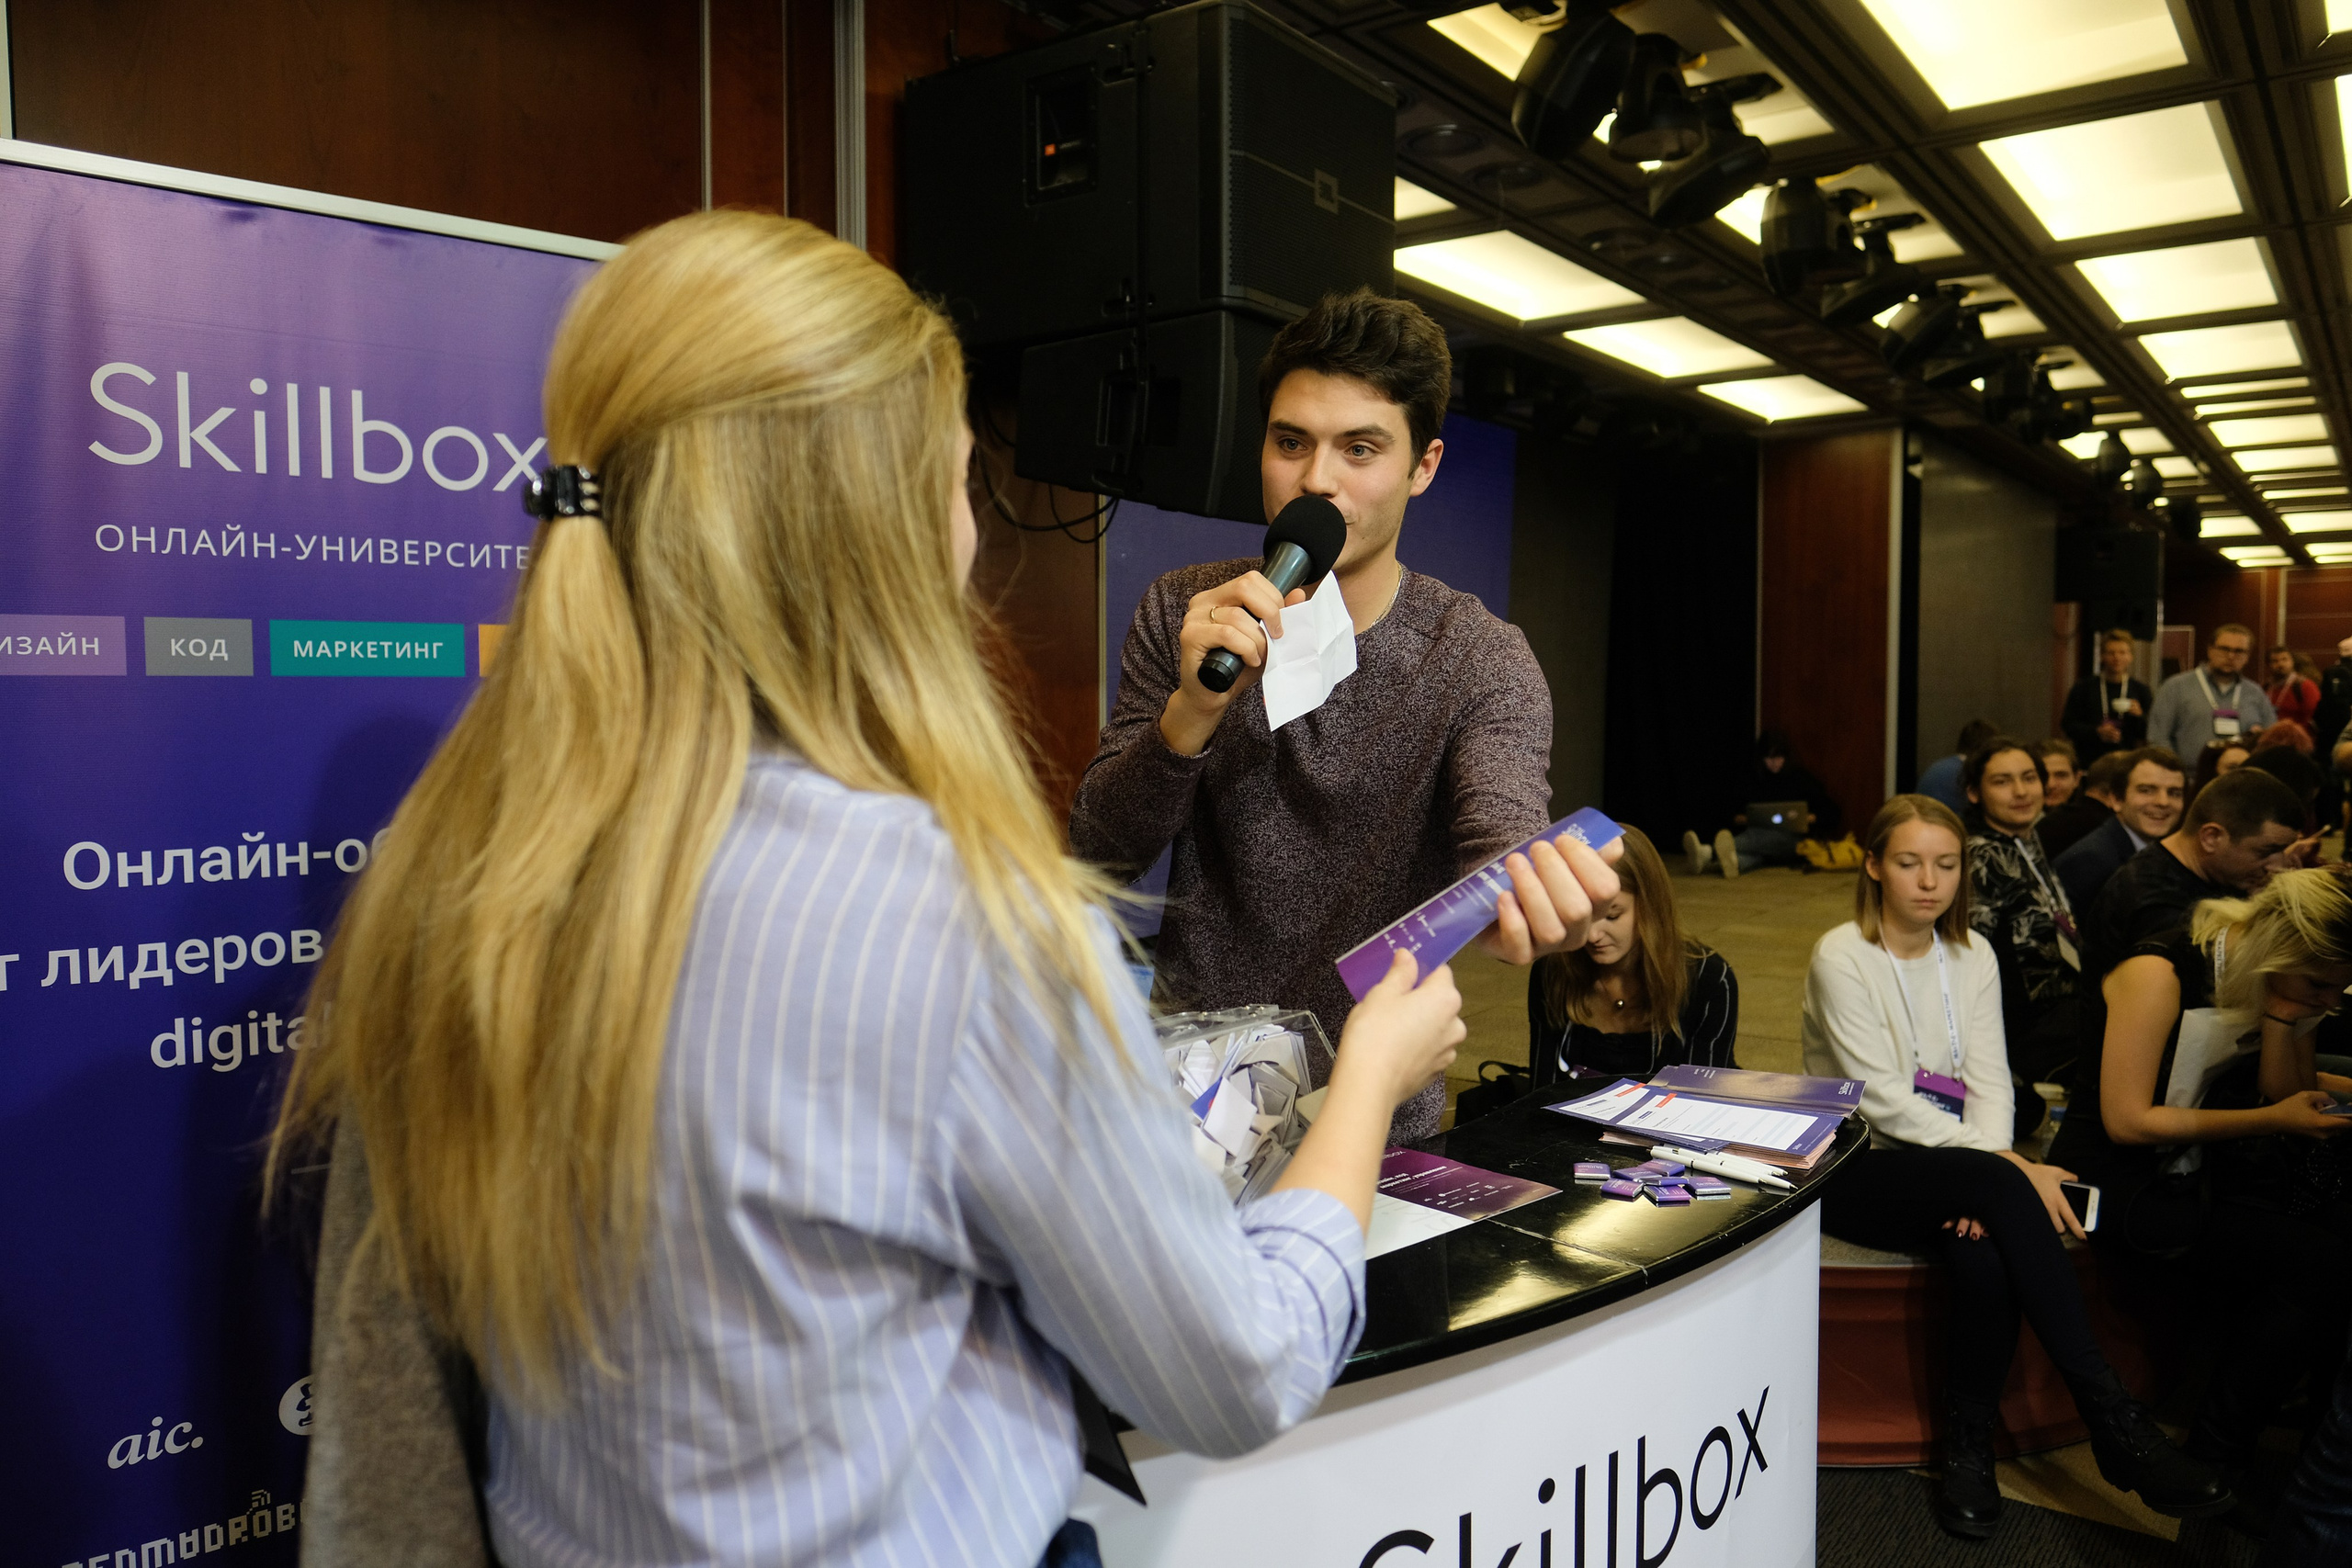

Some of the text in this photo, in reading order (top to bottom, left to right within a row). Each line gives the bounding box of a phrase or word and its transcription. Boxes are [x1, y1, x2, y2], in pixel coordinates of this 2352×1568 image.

[88, 362, 548, 492] Skillbox
[95, 524, 530, 570] ОНЛАЙН-УНИВЕРСИТЕ
[0, 631, 99, 656] ИЗАЙН
[170, 637, 230, 661] КОД
[292, 638, 445, 660] МАРКЕТИНГ
[63, 828, 390, 890] Онлайн-о
[40, 928, 324, 990] лидеров
[107, 1416, 204, 1470] aic.
[1356, 1384, 1770, 1568] illbox
